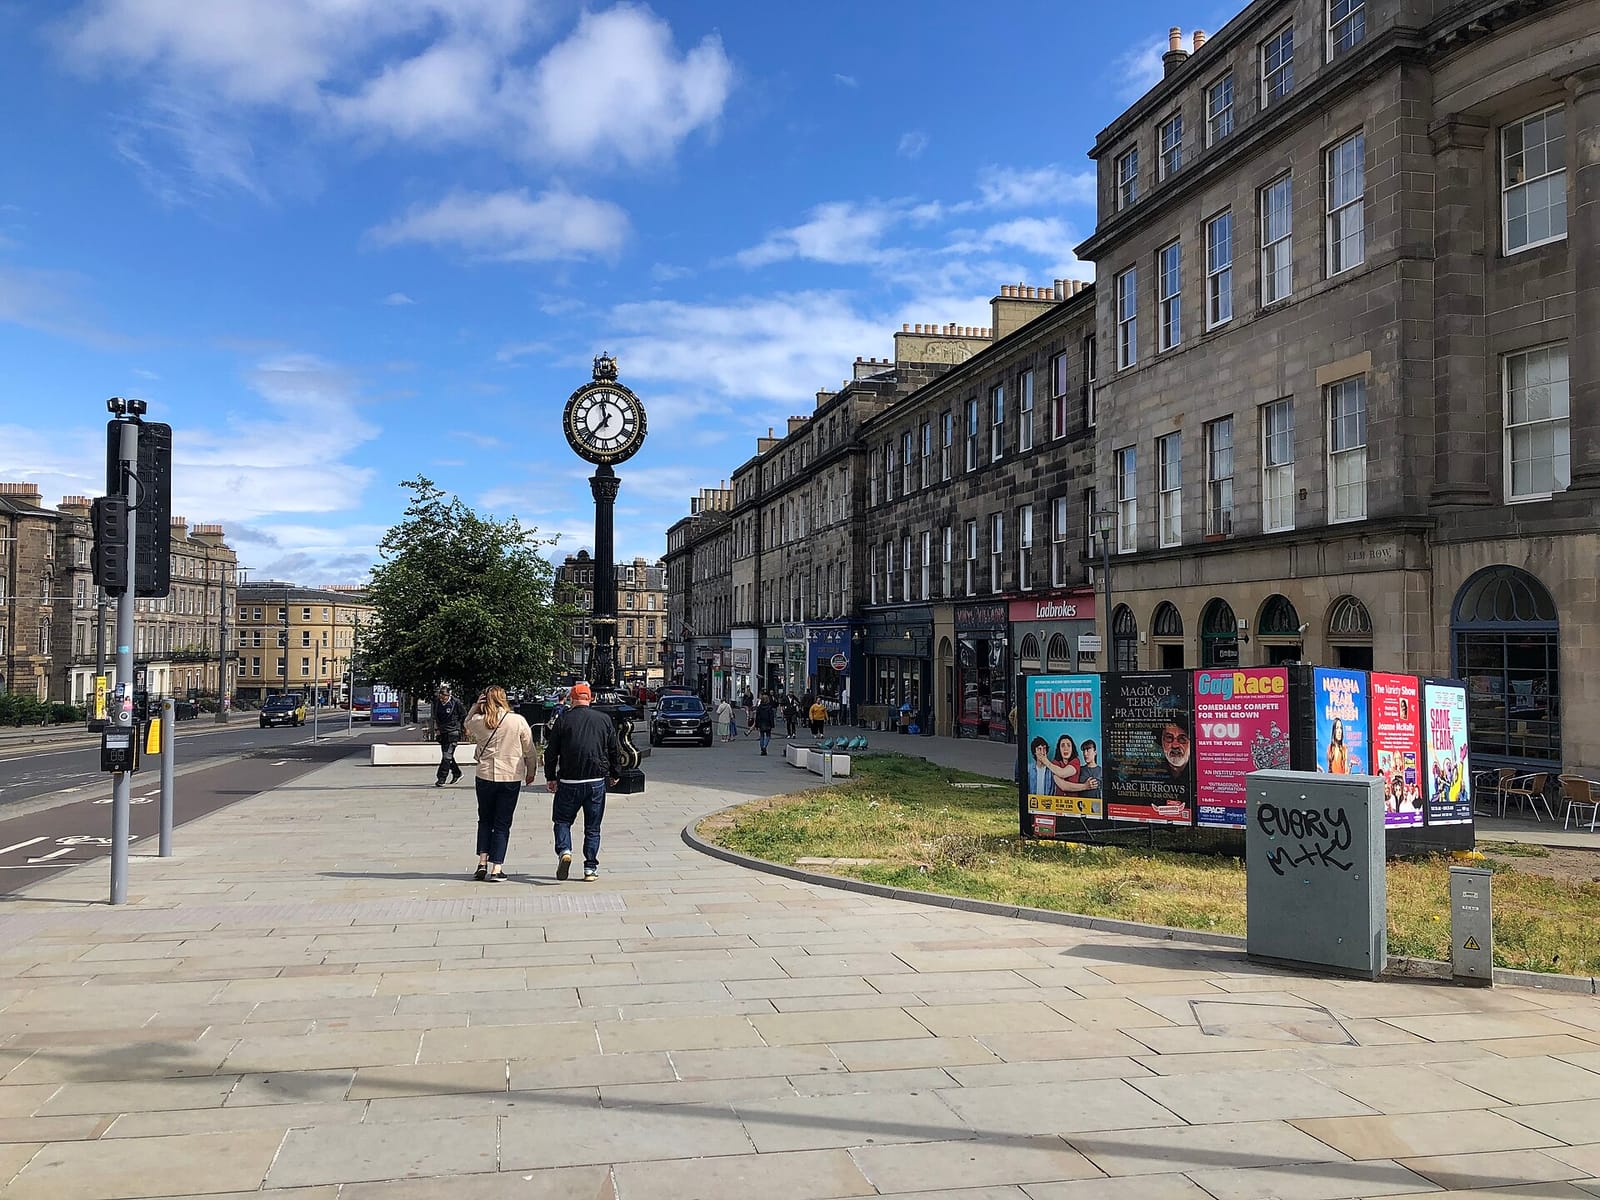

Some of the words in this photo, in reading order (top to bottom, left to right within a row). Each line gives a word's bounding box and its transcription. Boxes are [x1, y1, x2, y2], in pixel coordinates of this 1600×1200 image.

[1369, 548, 1391, 559] ROW
[1036, 600, 1077, 618] Ladbrokes
[1120, 686, 1155, 698] MAGIC
[1157, 685, 1172, 697] OF
[1322, 677, 1360, 694] NATASHA
[1374, 684, 1385, 694] The
[1385, 685, 1401, 697] Variety
[1401, 686, 1416, 696] Show
[373, 692, 386, 703] TO
[1126, 697, 1162, 707] TERRY
[1035, 691, 1093, 719] FLICKER
[1115, 708, 1179, 718] PRATCHETT
[1430, 708, 1451, 730] SAME
[1200, 723, 1240, 738] YOU
[1378, 722, 1395, 730] Joanne
[1396, 723, 1415, 733] McNally
[1431, 729, 1452, 750] TEAM
[1111, 782, 1138, 792] MARC
[1140, 783, 1186, 795] BURROWS
